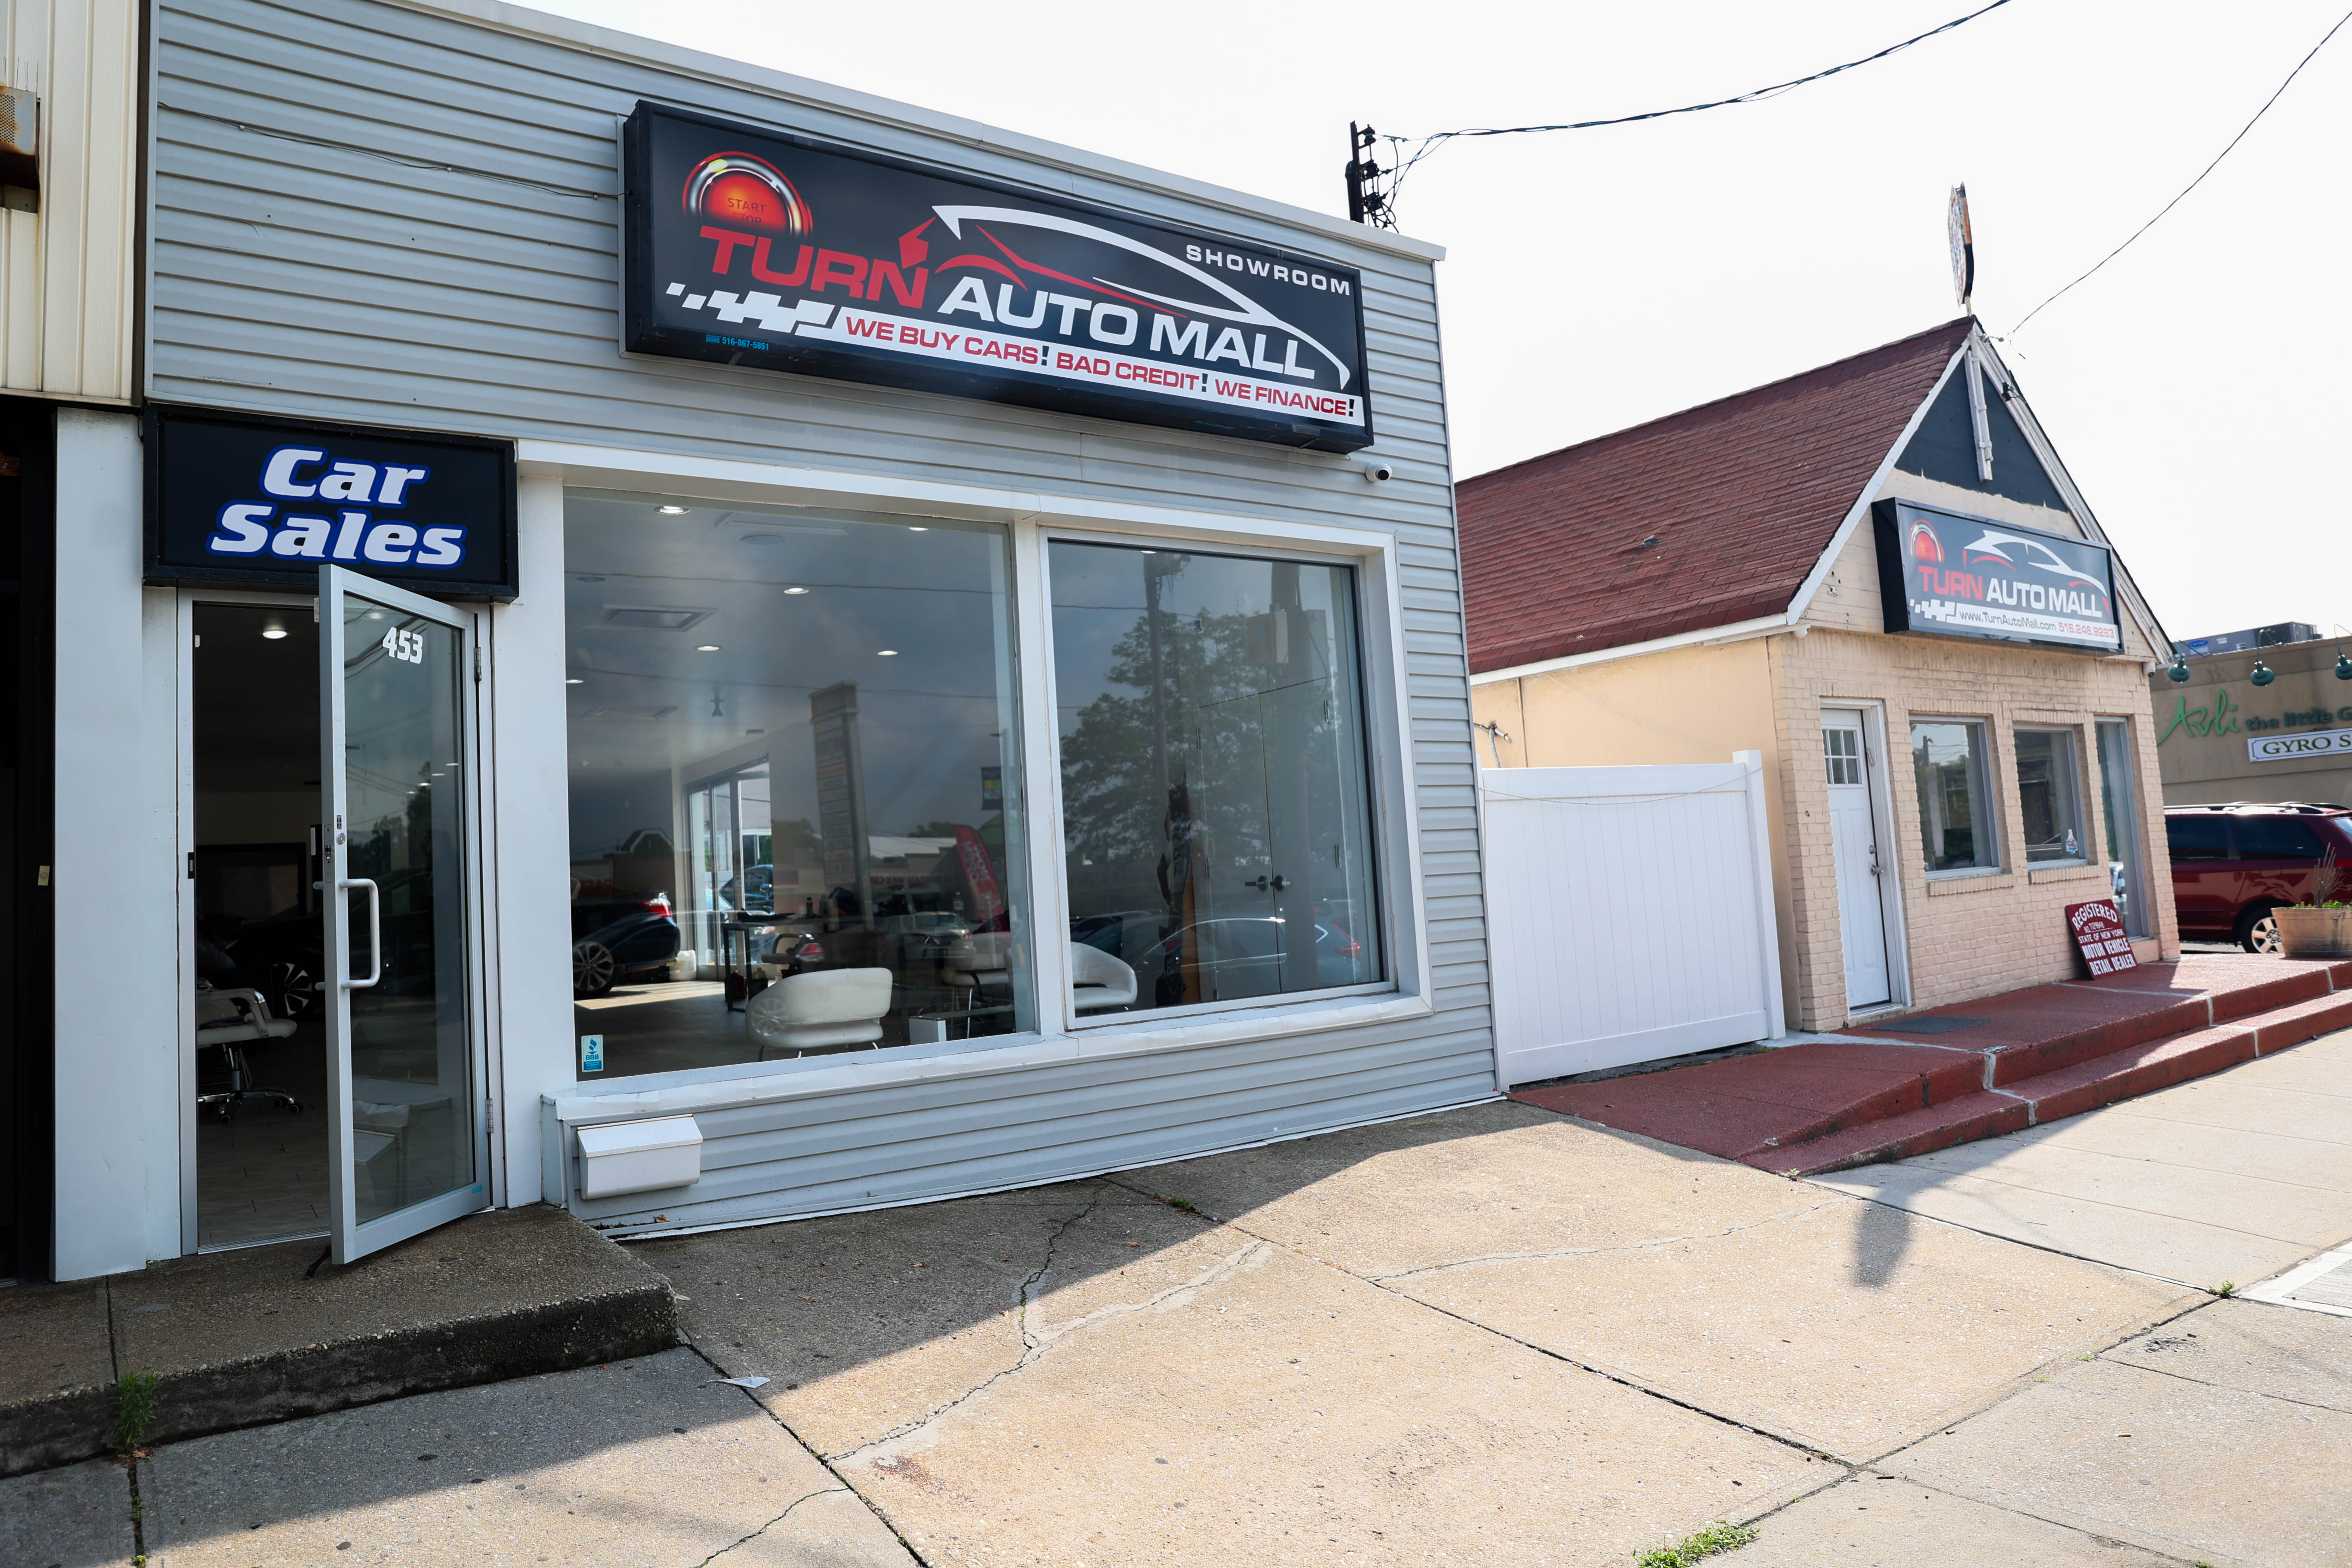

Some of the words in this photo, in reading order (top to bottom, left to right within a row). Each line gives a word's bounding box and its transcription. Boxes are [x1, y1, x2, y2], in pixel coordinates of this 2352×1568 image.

[727, 198, 766, 213] START
[1186, 244, 1350, 296] SHOWROOM
[699, 225, 929, 309] TURN
[937, 276, 1138, 346] AUTO
[1149, 313, 1314, 380] MALL
[722, 337, 769, 350] 516-867-5851
[846, 316, 894, 340] WE
[899, 327, 960, 351] BUY
[964, 337, 1049, 366] CARS!
[1056, 352, 1111, 375] BAD
[1115, 362, 1208, 392] CREDIT!
[1214, 379, 1251, 400] WE
[1255, 387, 1355, 417] FINANCE!
[263, 448, 427, 505] Car
[211, 504, 463, 566] Sales
[1918, 565, 1983, 600] TURN
[1986, 578, 2045, 610] AUTO
[2048, 587, 2102, 618] MALL
[1959, 611, 2056, 632] www.TurnAutoMall.com
[2058, 622, 2115, 638] 516.246.9283
[383, 627, 423, 665] 453
[2246, 716, 2279, 731] the
[2284, 710, 2333, 727] little
[2263, 737, 2331, 755] GYRO
[2072, 903, 2118, 931] REGISTERED
[2078, 934, 2094, 944] STATE
[2093, 932, 2100, 941] OF
[2100, 931, 2111, 939] NEW
[2111, 928, 2125, 937] YORK
[2081, 942, 2106, 960] MOTOR
[2103, 937, 2131, 955] VEHICLE
[2089, 958, 2114, 976] RETAIL
[2110, 953, 2137, 971] DEALER
